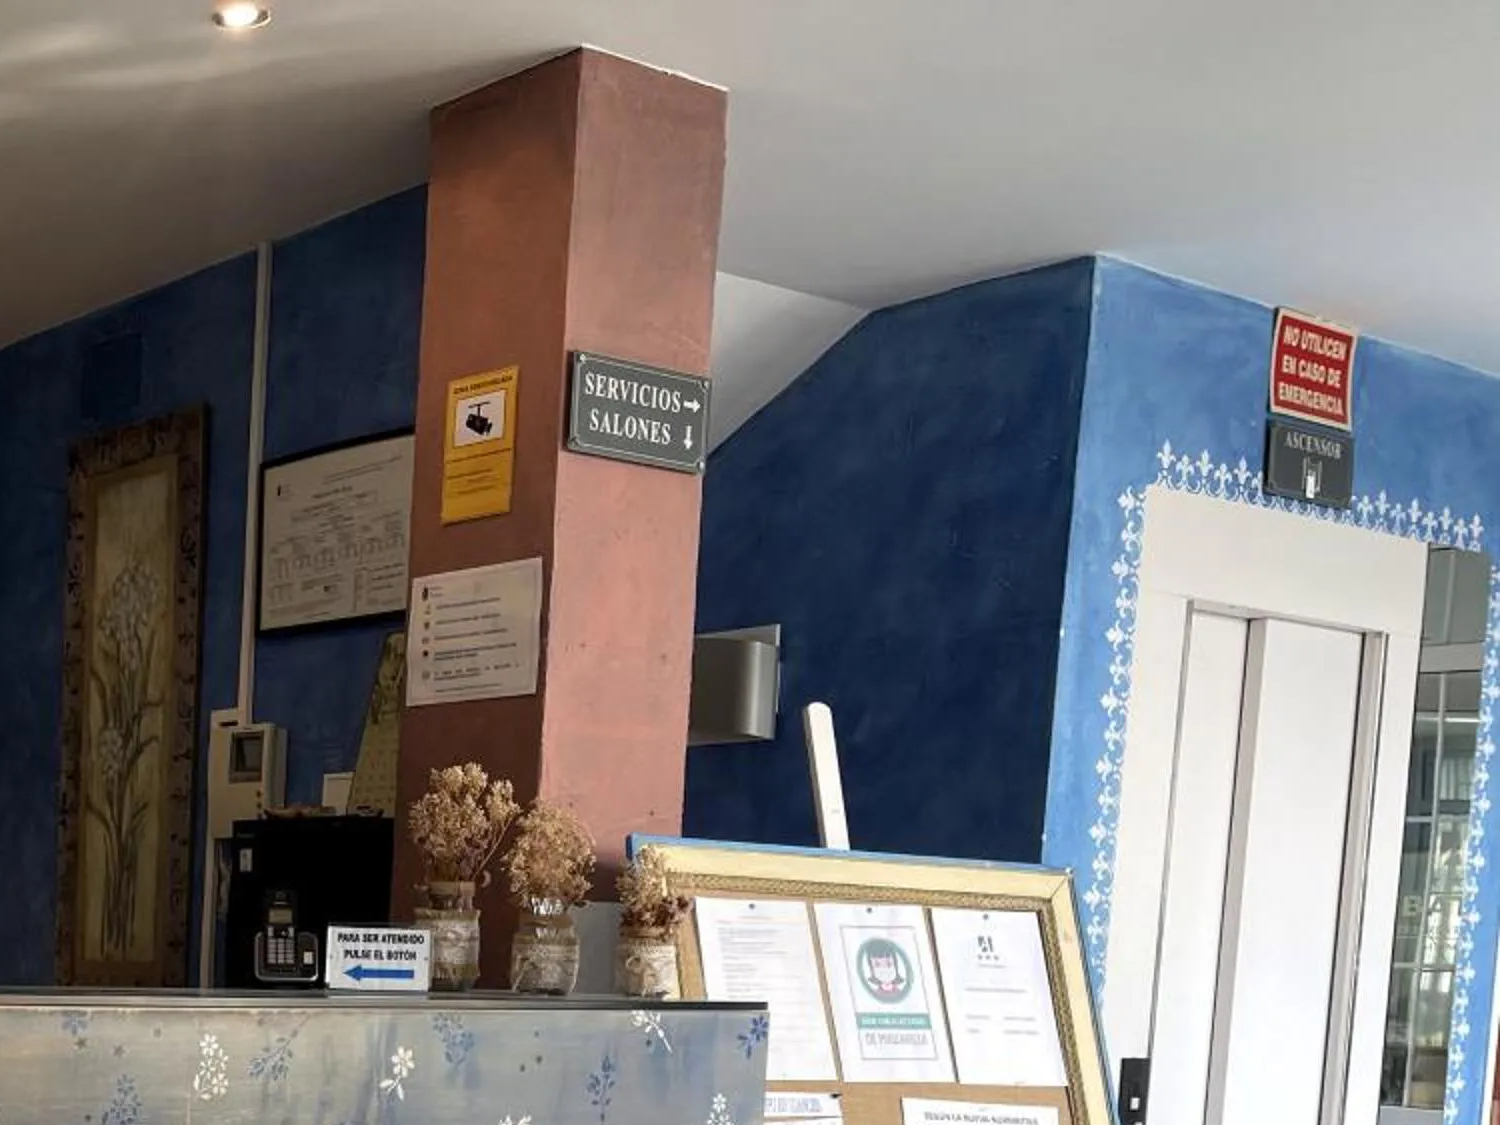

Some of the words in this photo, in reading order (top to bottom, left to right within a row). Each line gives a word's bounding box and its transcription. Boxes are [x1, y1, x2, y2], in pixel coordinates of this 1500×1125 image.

[1284, 325, 1300, 347] NO
[1282, 355, 1297, 374] EN
[1298, 359, 1326, 383] CASO
[1327, 368, 1342, 388] DE
[585, 371, 681, 413] SERVICIOS
[1278, 382, 1345, 415] EMERGENCIA
[589, 408, 671, 445] SALONES
[1285, 432, 1341, 459] ASCENSOR
[381, 933, 425, 945] ATENDIDO
